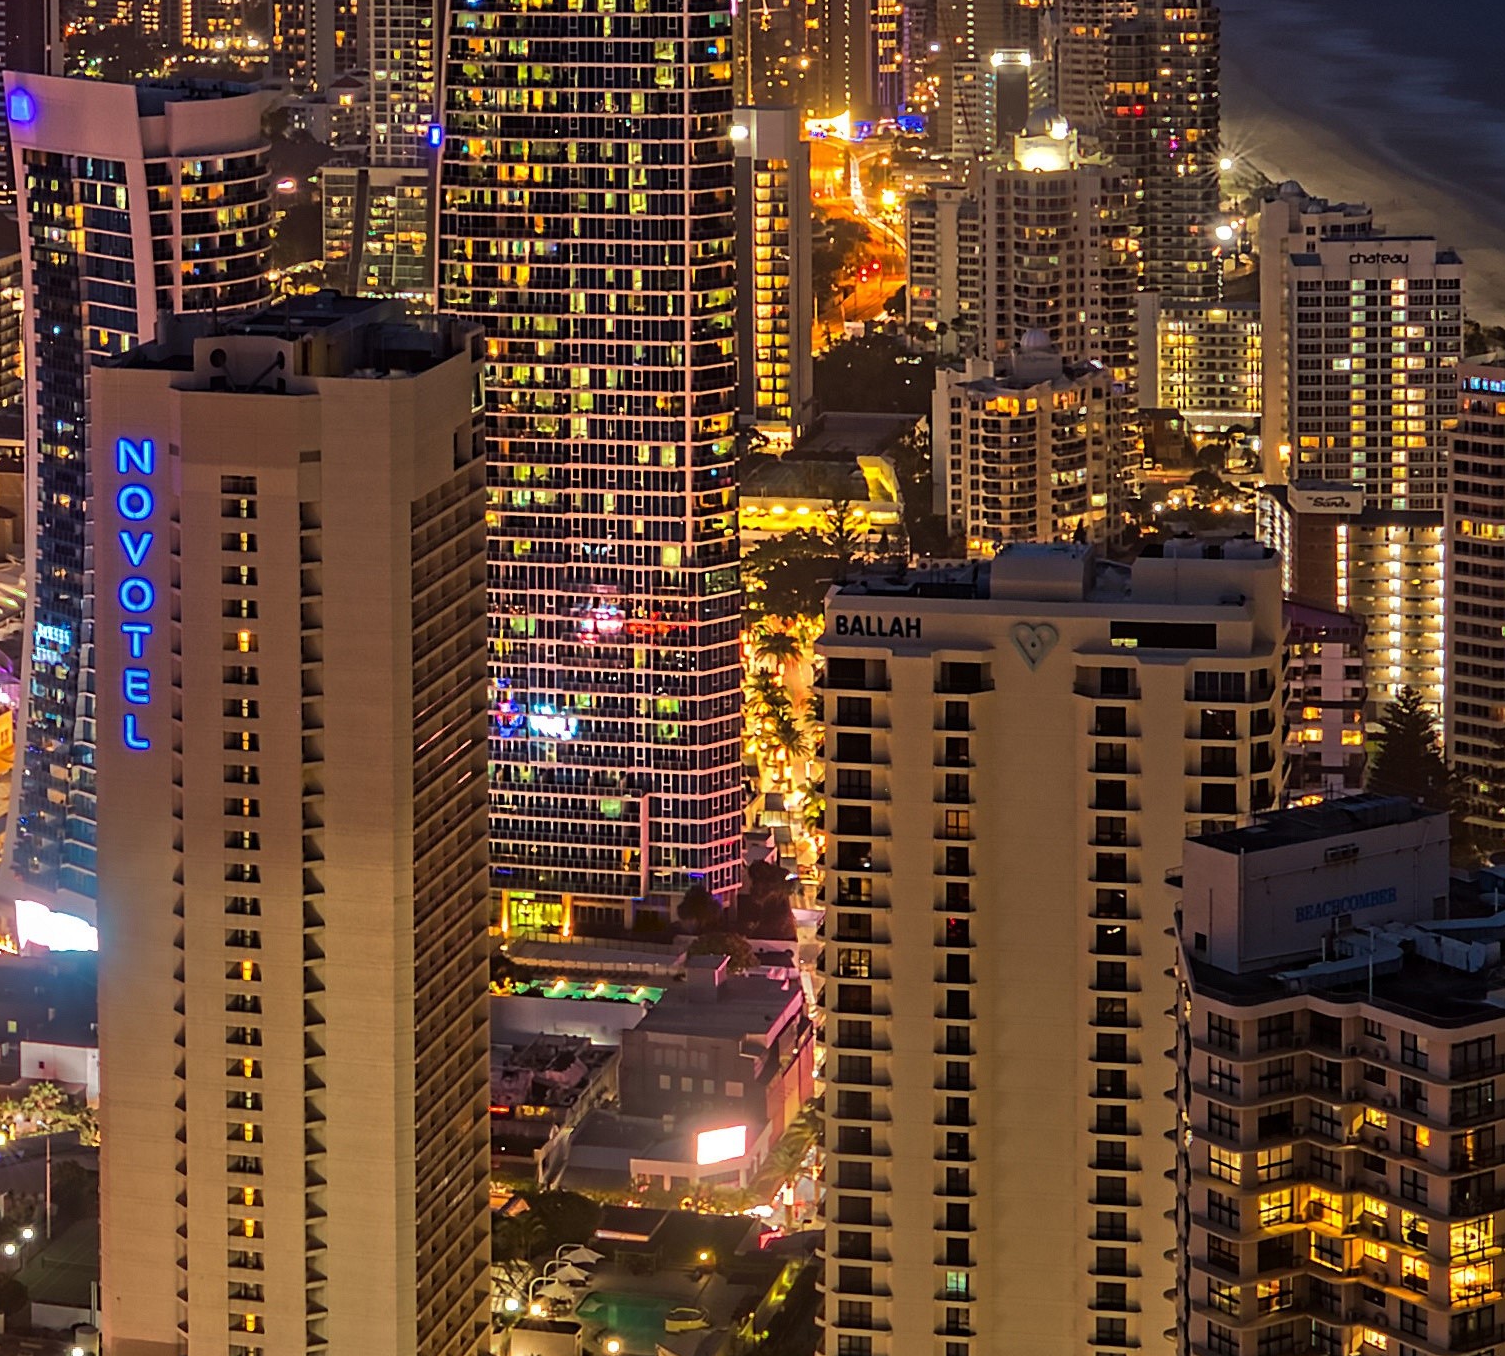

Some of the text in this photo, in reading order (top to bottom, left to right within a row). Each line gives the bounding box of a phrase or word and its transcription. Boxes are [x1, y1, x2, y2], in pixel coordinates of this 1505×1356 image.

[1350, 253, 1409, 264] chateau
[117, 437, 155, 749] NOVOTEL
[836, 615, 921, 638] BALLAH
